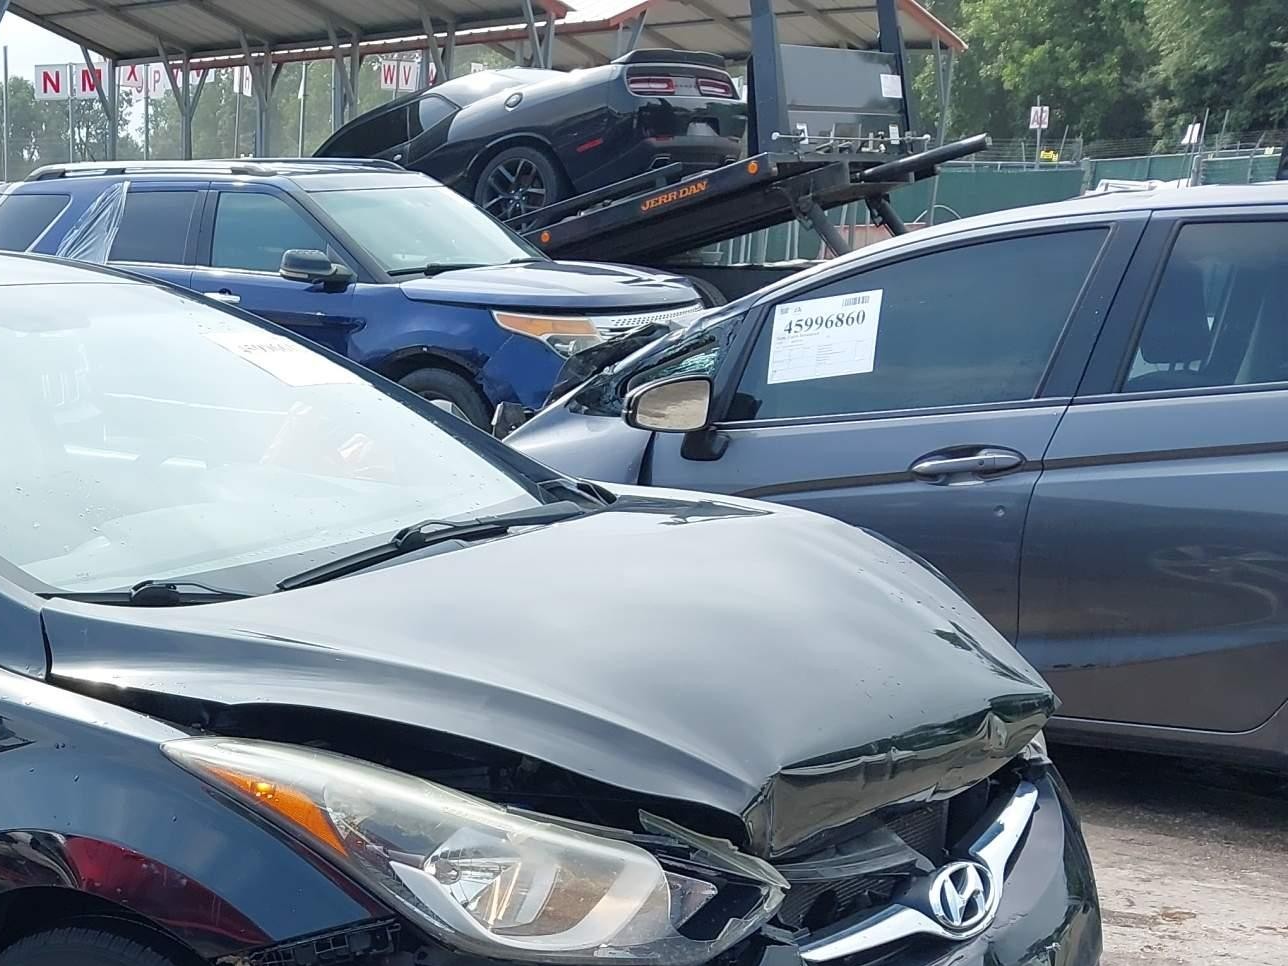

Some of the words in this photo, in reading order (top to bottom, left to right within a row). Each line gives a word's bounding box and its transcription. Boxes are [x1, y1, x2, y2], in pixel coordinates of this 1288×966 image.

[43, 71, 60, 94] N
[81, 69, 102, 92] M
[383, 64, 395, 84] W
[403, 66, 411, 85] V
[640, 191, 678, 212] JERR
[679, 180, 708, 199] DAN
[784, 309, 866, 335] 45996860
